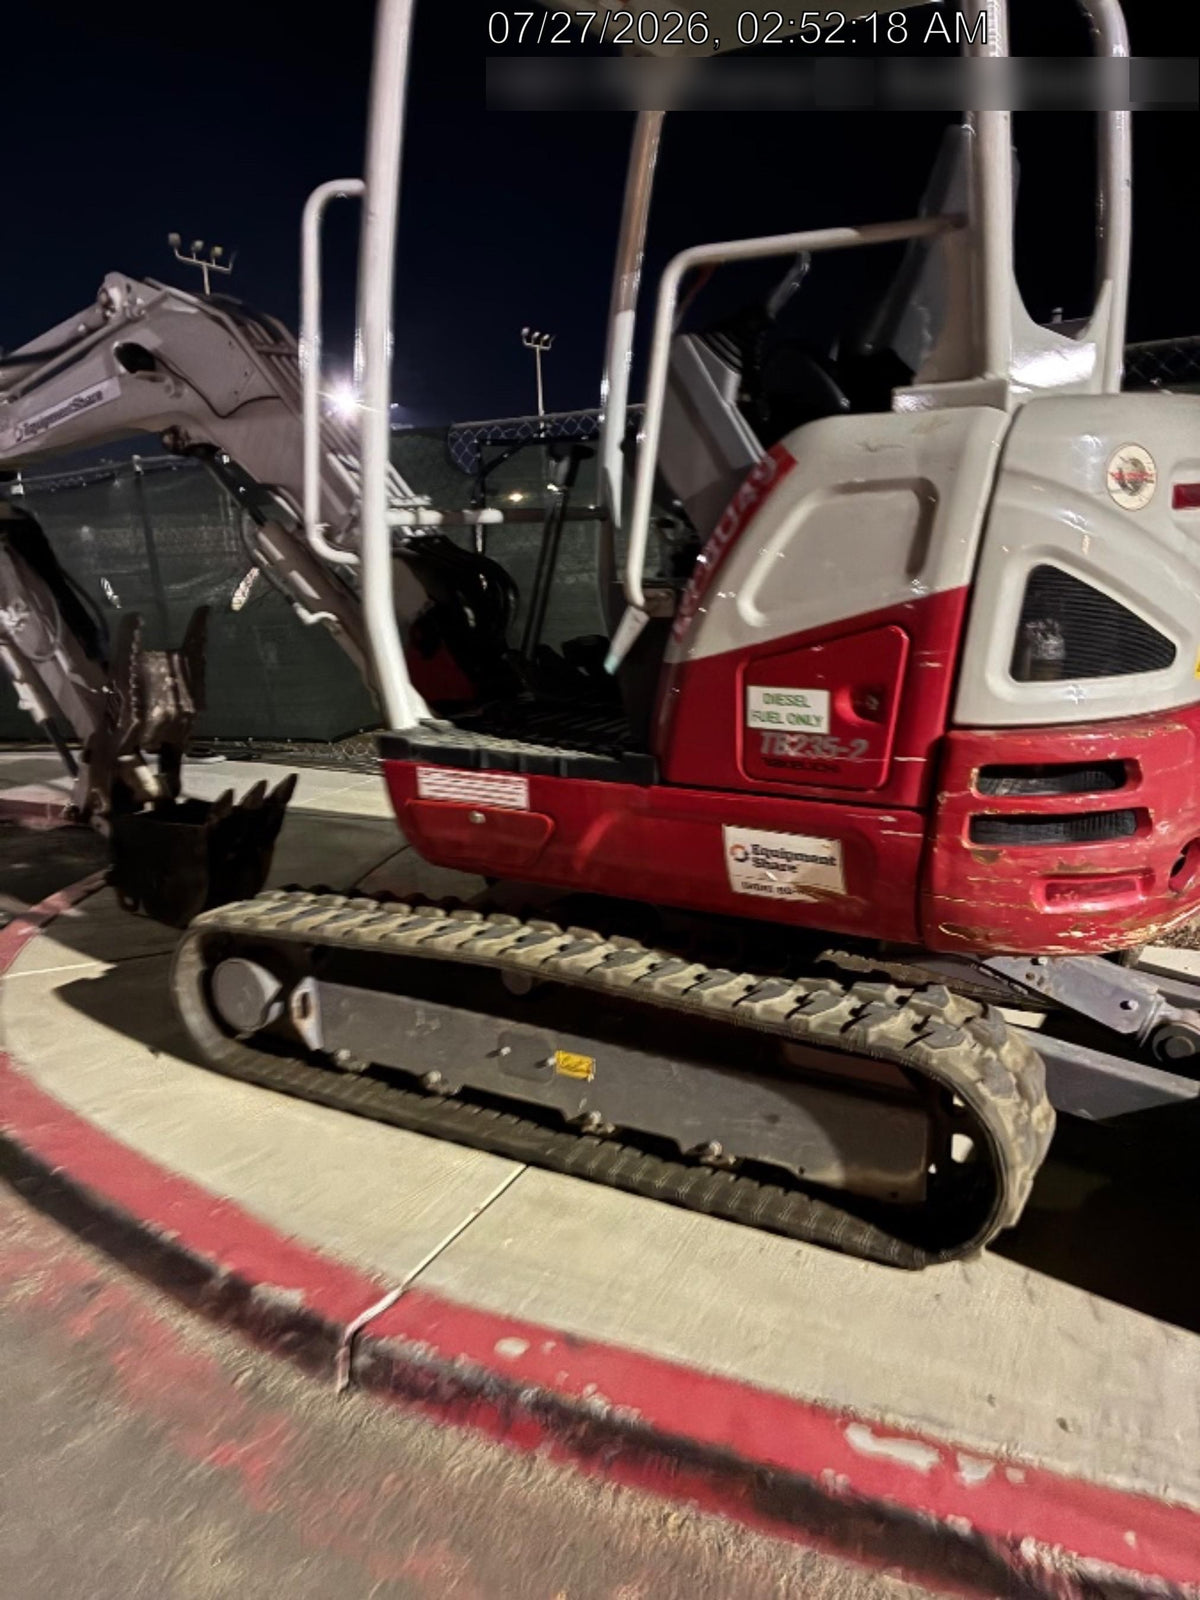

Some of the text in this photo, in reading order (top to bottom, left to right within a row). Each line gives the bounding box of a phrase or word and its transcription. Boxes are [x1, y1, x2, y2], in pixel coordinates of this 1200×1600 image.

[762, 692, 812, 708] DIESEL
[751, 710, 824, 728] FUEL ONLY
[760, 731, 869, 762] TB235-2
[751, 844, 836, 867] Equipment
[751, 857, 798, 874] Share
